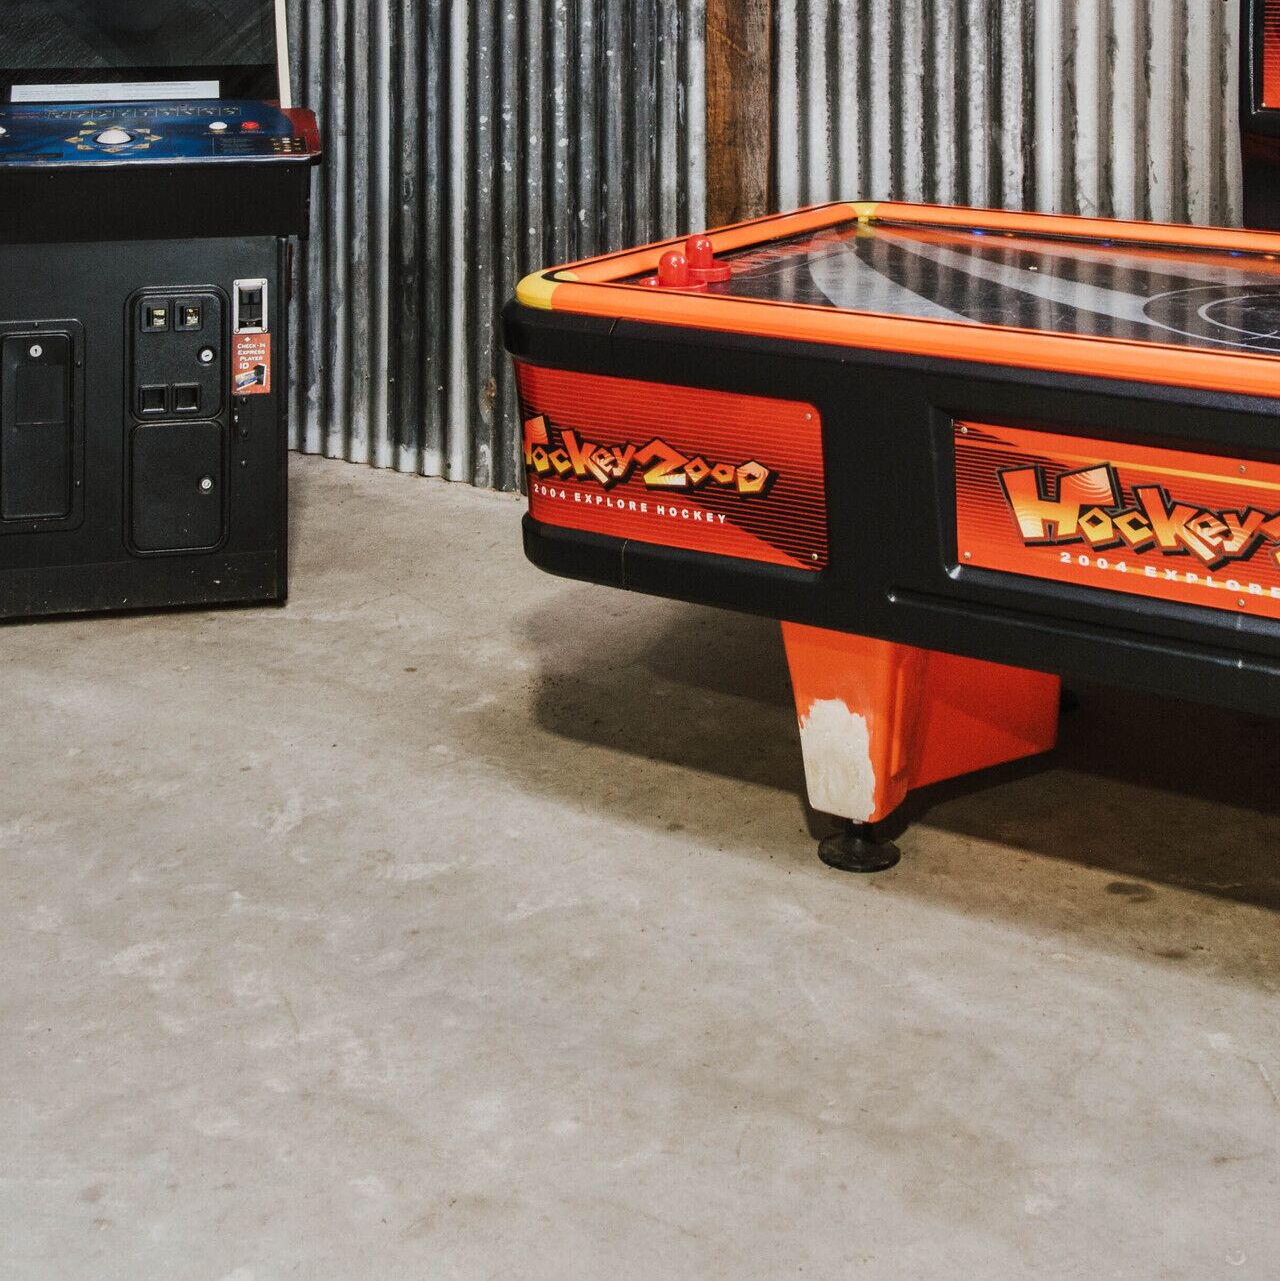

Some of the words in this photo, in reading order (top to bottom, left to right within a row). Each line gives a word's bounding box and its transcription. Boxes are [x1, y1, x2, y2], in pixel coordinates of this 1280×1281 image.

[239, 362, 250, 370] ID
[534, 483, 567, 500] 2004
[574, 492, 649, 513] EXPLORE
[657, 504, 727, 525] HOCKEY
[1060, 551, 1129, 573] 2004
